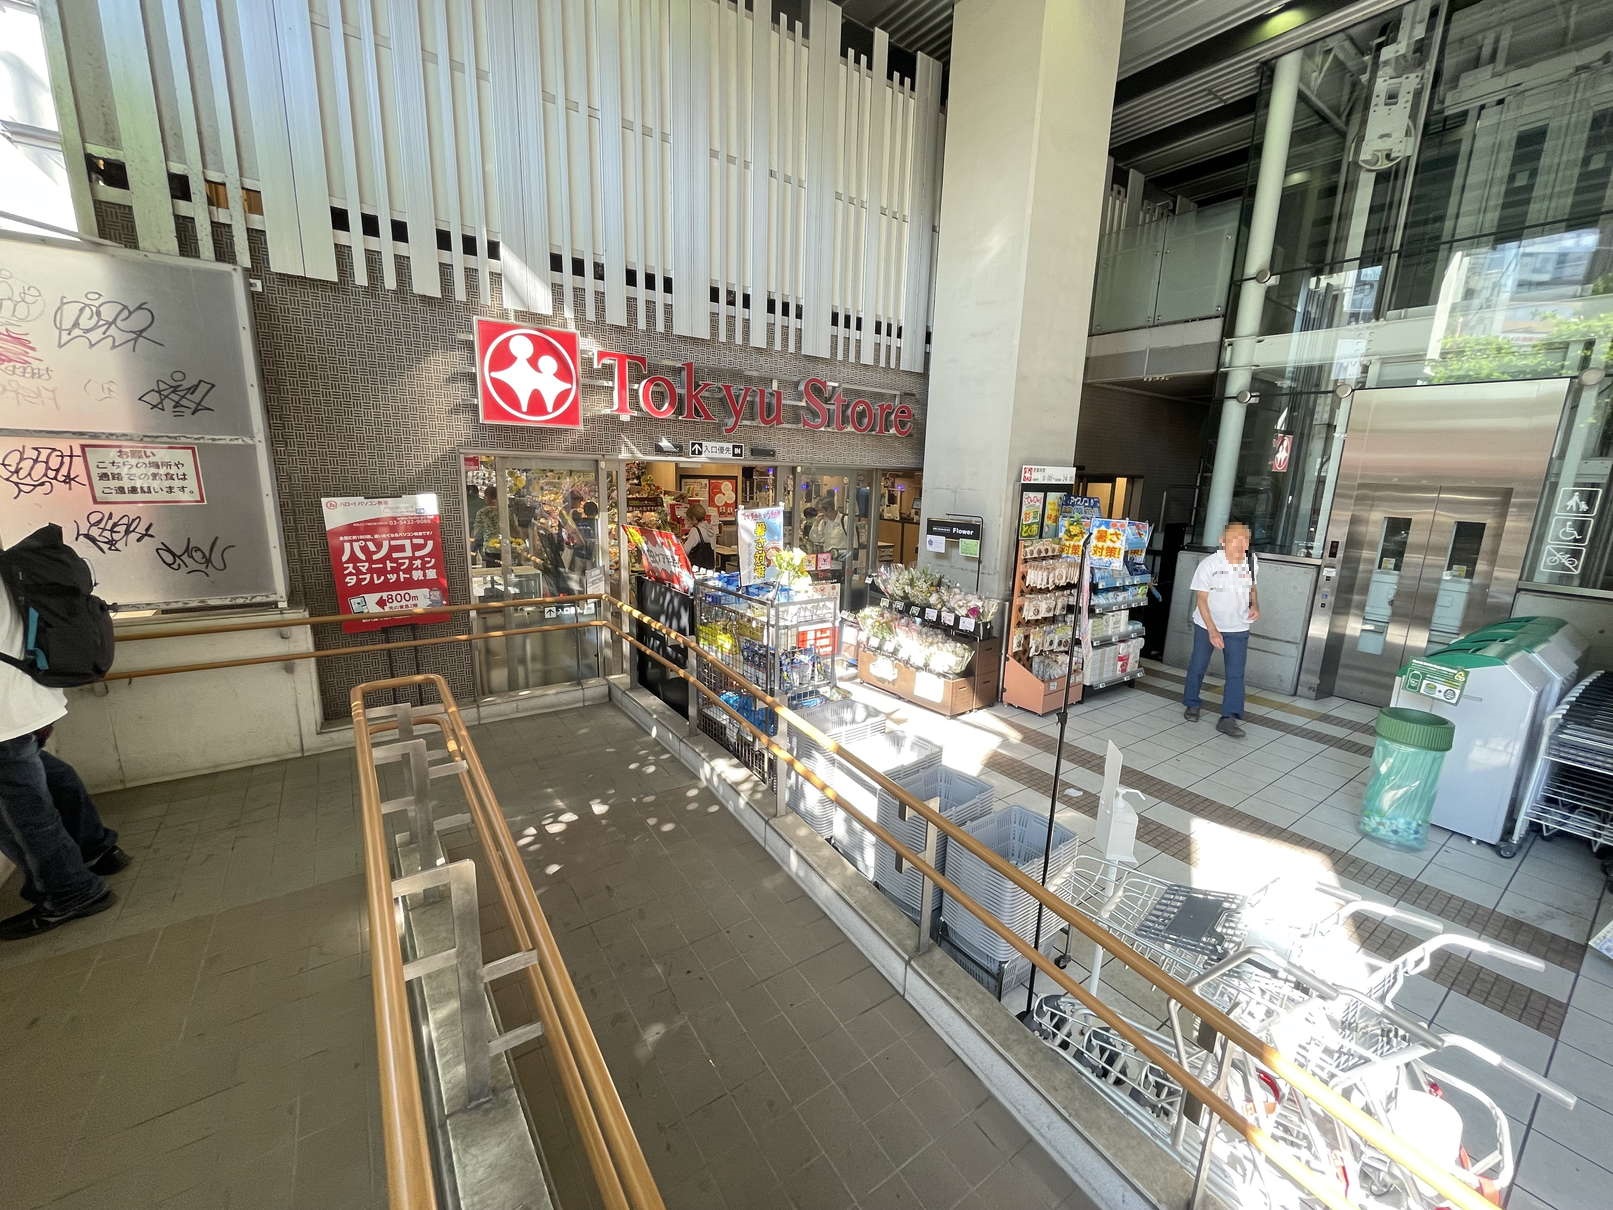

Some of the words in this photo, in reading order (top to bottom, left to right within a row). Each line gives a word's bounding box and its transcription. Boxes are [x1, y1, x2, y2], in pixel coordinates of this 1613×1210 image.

[595, 350, 784, 434] Tokyu
[802, 377, 914, 437] Store
[117, 449, 156, 459] お願い
[96, 460, 184, 470] こちらの場所や
[97, 472, 188, 481] 通路での飲食は
[102, 485, 194, 495] ご遠慮願います。
[952, 527, 974, 536] Flower
[342, 538, 434, 562] パソコン
[343, 557, 435, 574] スマートフォン
[344, 568, 437, 587] タブレット教室
[386, 592, 418, 604] 800m
